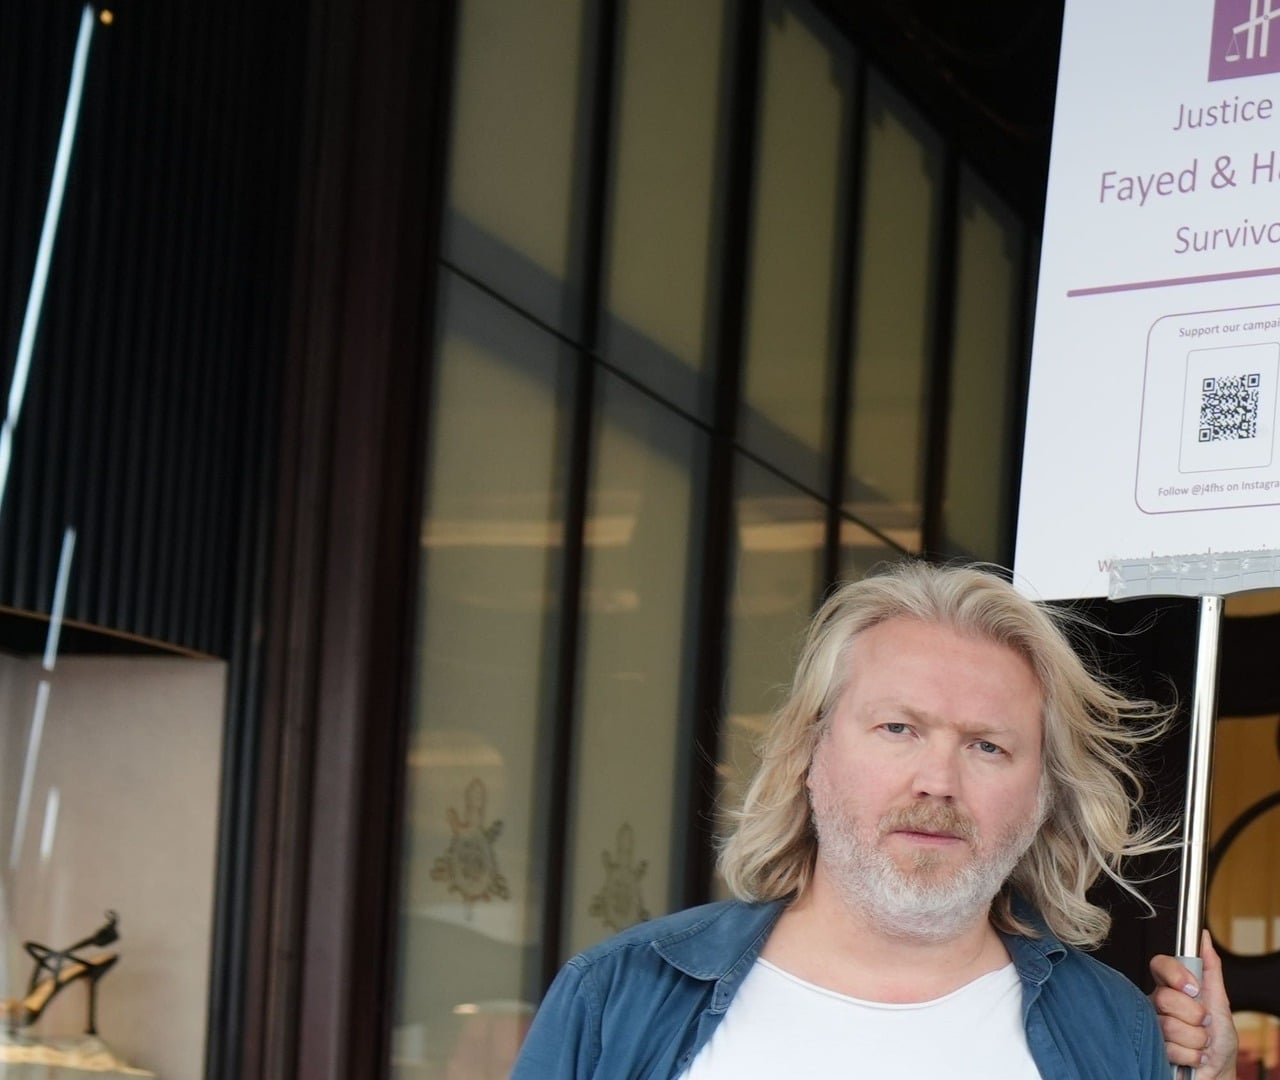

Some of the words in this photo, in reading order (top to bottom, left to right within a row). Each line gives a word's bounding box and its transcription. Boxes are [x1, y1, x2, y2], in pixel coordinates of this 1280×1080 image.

[1173, 96, 1272, 131] Justice
[1100, 158, 1197, 206] Fayed
[1211, 154, 1237, 189] &
[1179, 322, 1219, 338] Support
[1222, 324, 1240, 333] our
[1158, 486, 1188, 497] Follow
[1227, 482, 1239, 491] on
